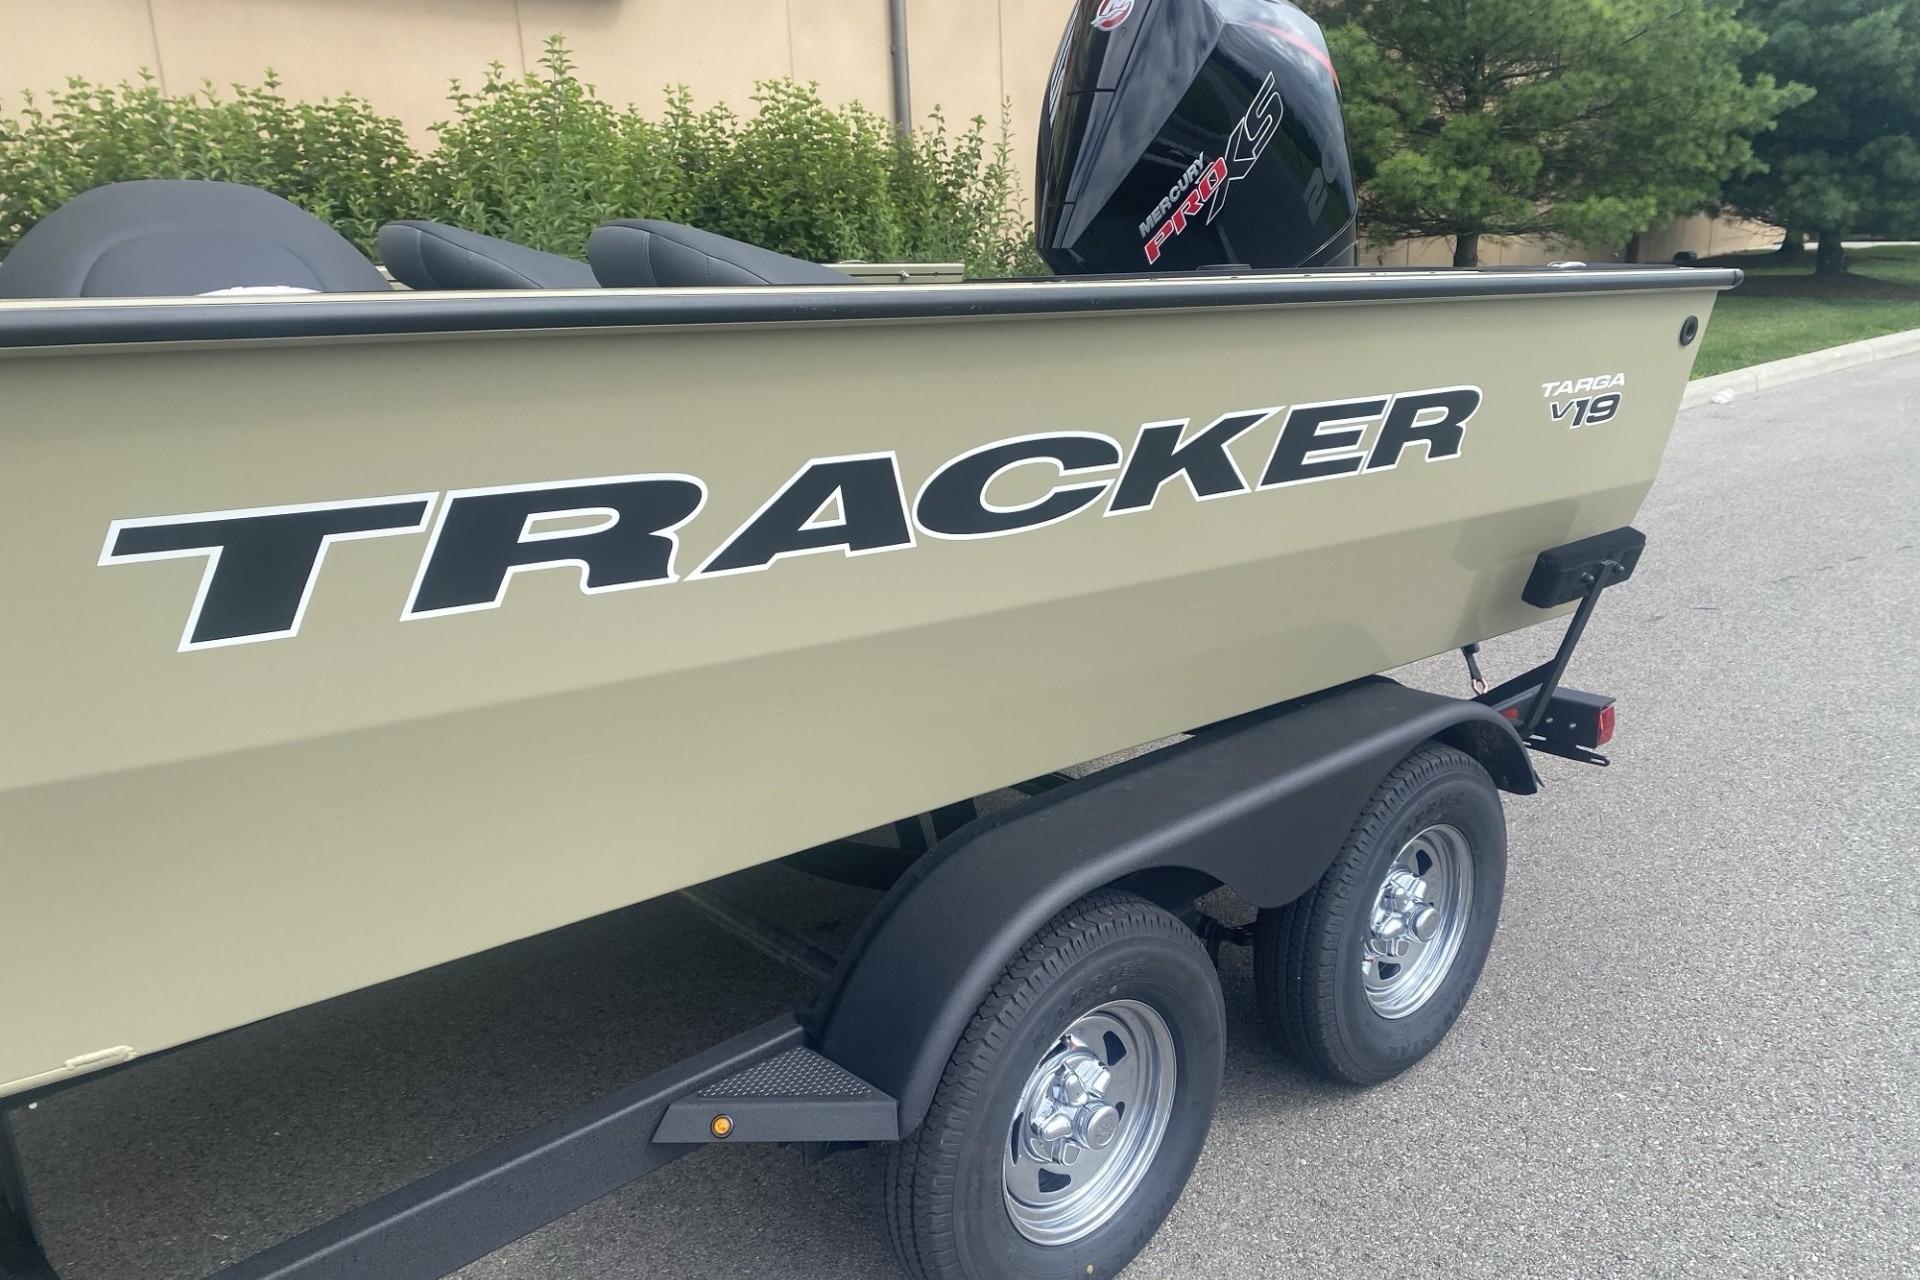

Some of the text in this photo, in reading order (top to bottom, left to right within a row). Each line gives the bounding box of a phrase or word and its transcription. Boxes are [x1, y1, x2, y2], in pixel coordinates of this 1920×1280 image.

[1138, 151, 1205, 239] MERCURY
[1144, 71, 1284, 265] PRO XS
[1541, 372, 1626, 398] TARGA
[1550, 391, 1622, 430] V19
[97, 384, 1483, 653] TRACKER
